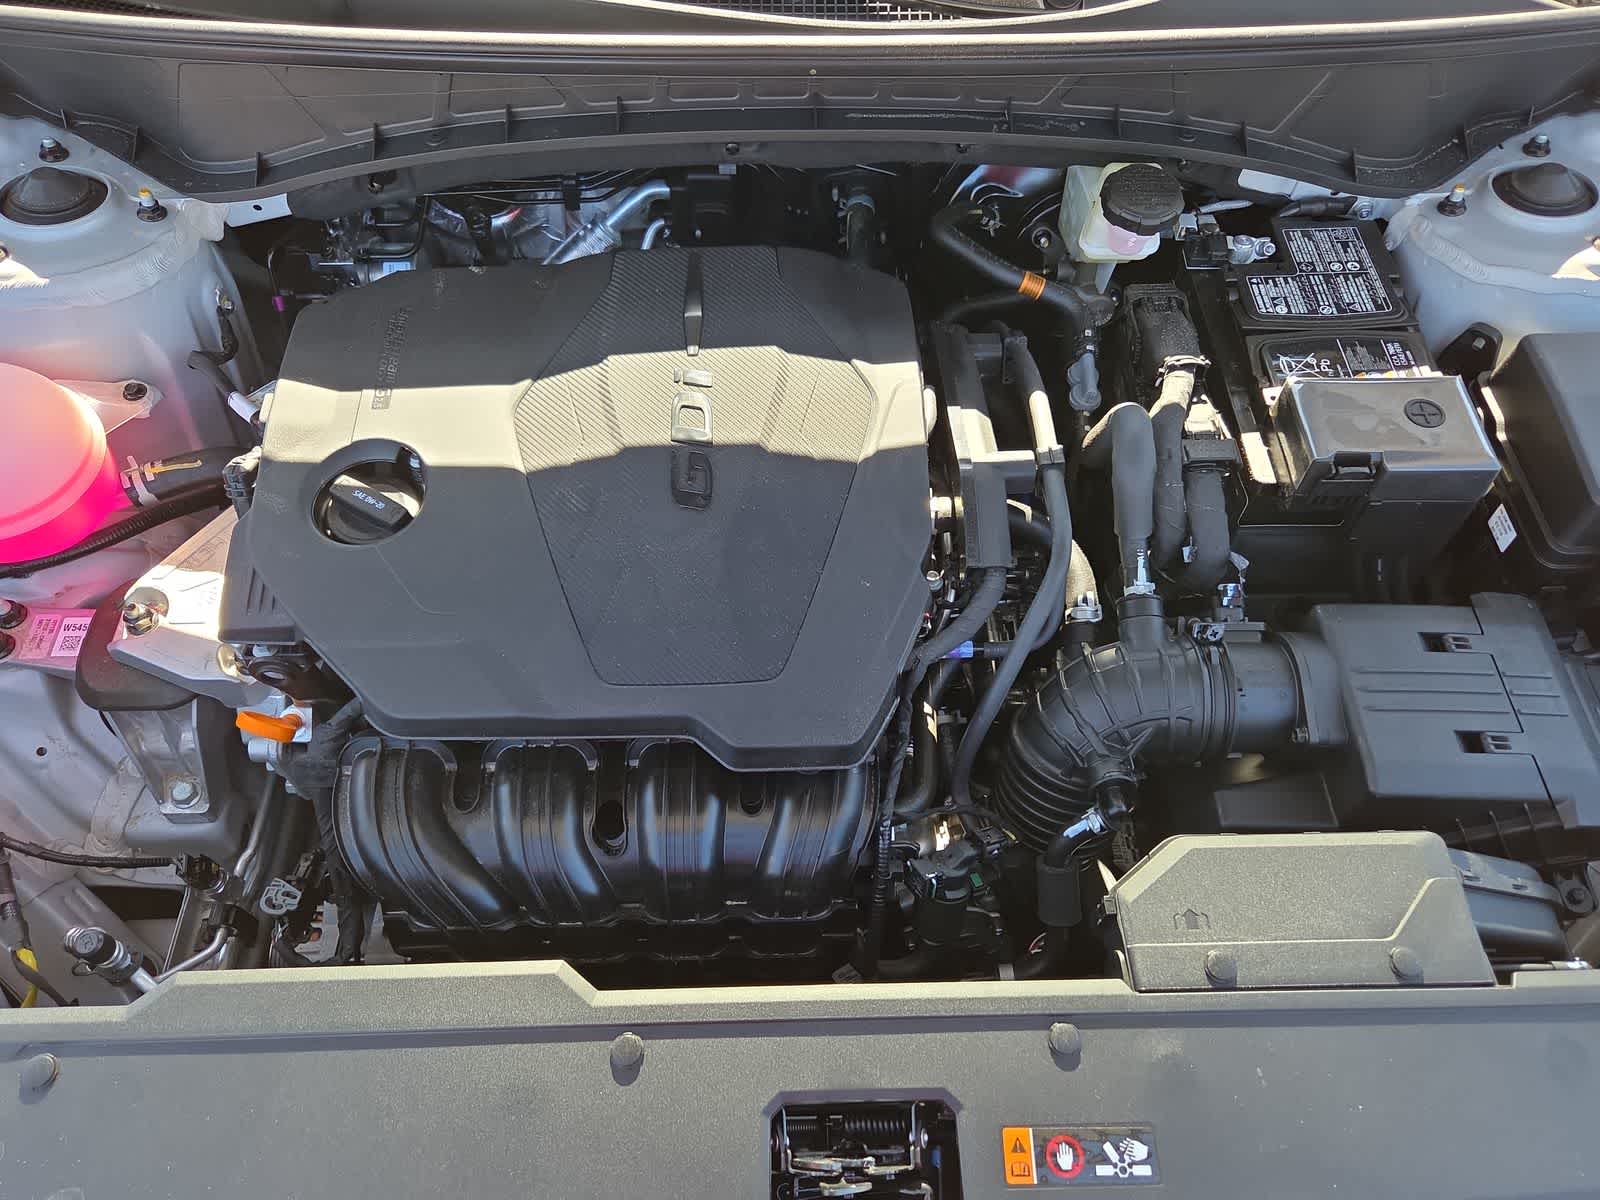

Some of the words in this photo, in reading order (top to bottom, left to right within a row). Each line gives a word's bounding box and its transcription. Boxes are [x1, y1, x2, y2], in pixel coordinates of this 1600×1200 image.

[1320, 359, 1334, 372] Pb
[352, 490, 367, 500] SAE
[364, 495, 386, 509] 0W-20
[63, 623, 89, 632] W545
